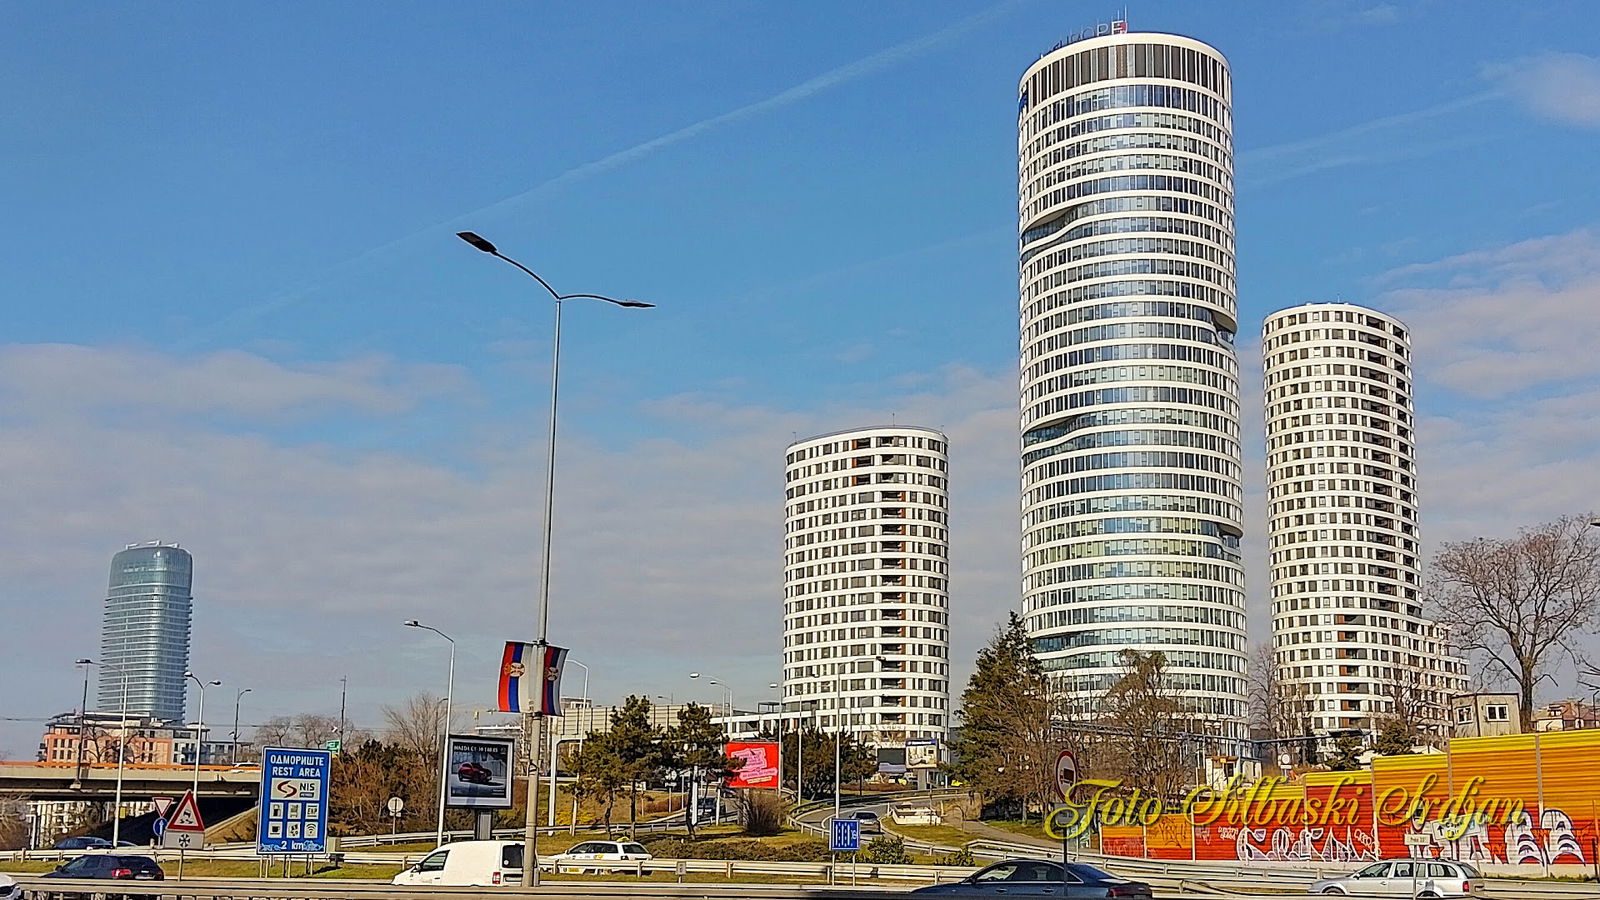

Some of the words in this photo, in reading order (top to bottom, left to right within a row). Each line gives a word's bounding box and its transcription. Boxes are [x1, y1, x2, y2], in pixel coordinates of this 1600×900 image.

[270, 755, 324, 766] ОДМОРИШТЕ
[272, 766, 294, 776] REST
[299, 768, 320, 777] AREA
[300, 782, 315, 791] NIS
[280, 840, 287, 850] 2
[291, 840, 304, 850] km
